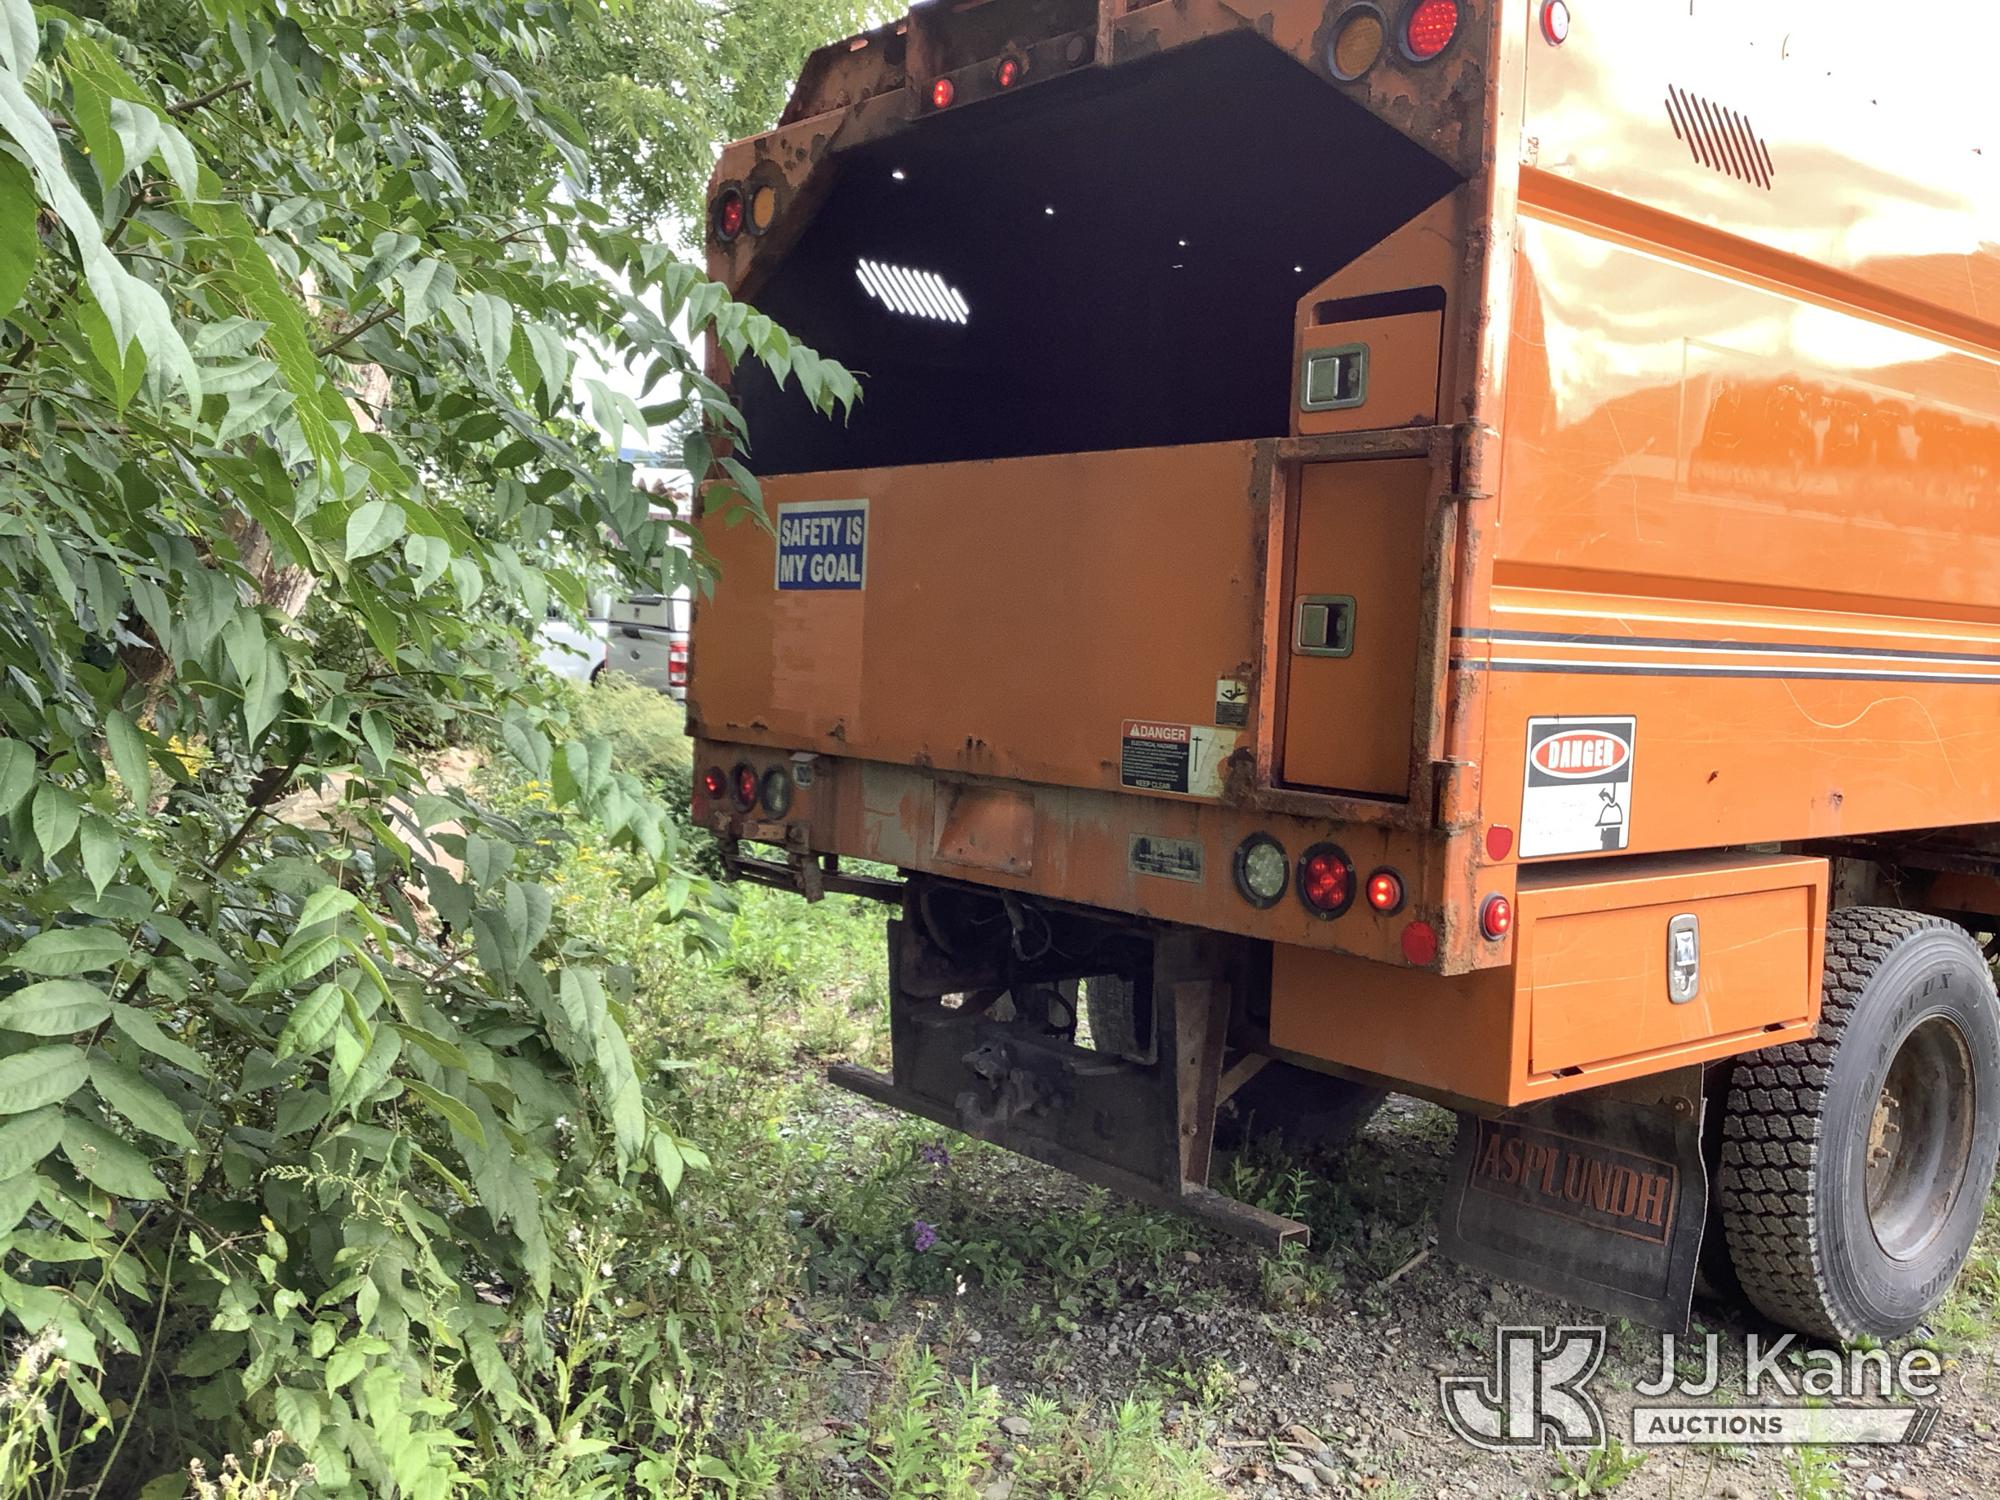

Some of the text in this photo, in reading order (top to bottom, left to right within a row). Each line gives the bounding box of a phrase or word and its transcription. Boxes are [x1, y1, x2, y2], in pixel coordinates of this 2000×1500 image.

[781, 515, 862, 546] SAFETY IS
[780, 553, 860, 582] MY GOAL
[1140, 725, 1186, 741] DANGER
[1547, 738, 1614, 768] DANGER
[1478, 1133, 1669, 1226] ASPLUNDH
